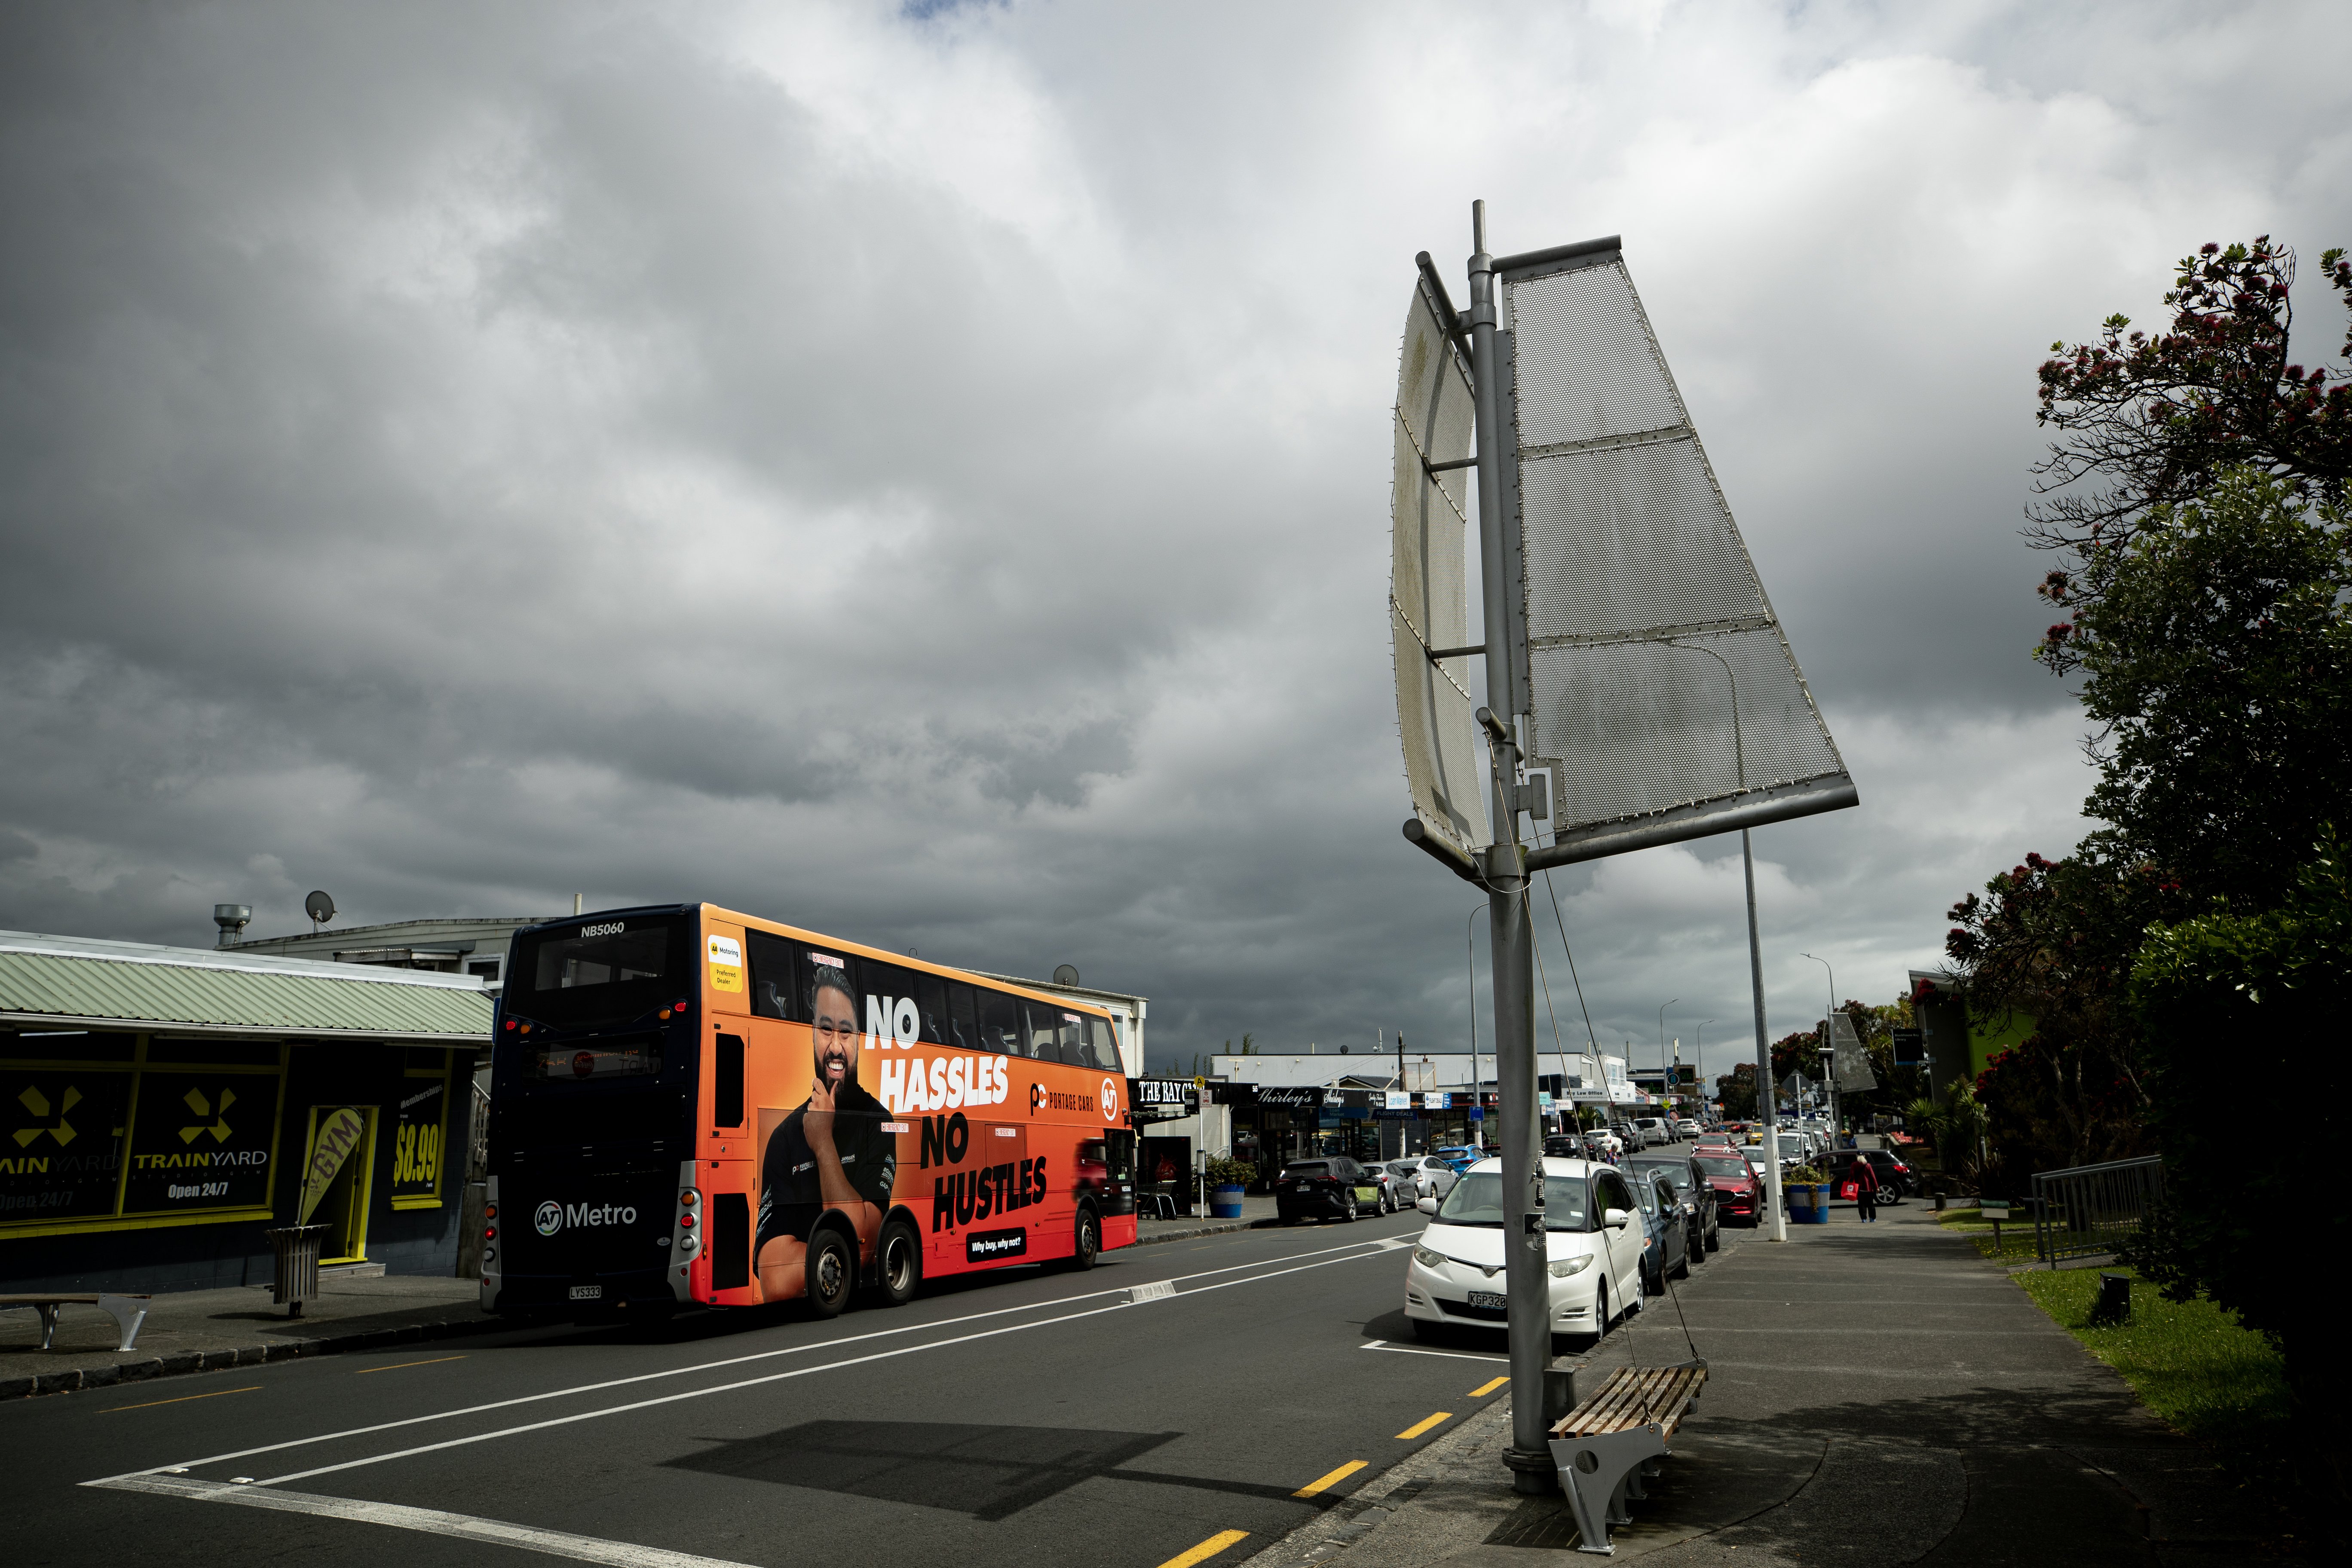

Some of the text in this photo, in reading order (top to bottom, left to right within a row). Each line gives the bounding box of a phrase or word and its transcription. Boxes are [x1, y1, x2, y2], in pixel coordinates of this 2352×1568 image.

[581, 922, 624, 937] NB5060
[720, 947, 738, 958] Motoring
[818, 955, 835, 965] EMERGENCY
[717, 969, 736, 977] Preferred
[865, 994, 920, 1049] NO
[879, 1055, 1008, 1114] HASSLES
[1139, 1081, 1160, 1102] THE
[1162, 1081, 1181, 1102] BAY
[401, 1084, 443, 1109] Memberships
[1049, 1092, 1076, 1111] PORTAGE
[1078, 1095, 1093, 1112] CARS
[1259, 1087, 1313, 1107] Shirley's
[1323, 1089, 1344, 1107] Shirley's
[1396, 1096, 1407, 1105] Market
[887, 1123, 900, 1131] EMERGENCY
[312, 1113, 360, 1179] GYM
[920, 1112, 969, 1170] NO
[133, 1151, 267, 1169] TRAINYARD
[393, 1121, 439, 1187] $8.99
[168, 1182, 229, 1199] Open 24/7
[880, 1181, 888, 1189] GAP
[39, 1190, 74, 1207] 24/7
[932, 1156, 1047, 1234] HUSTLES
[566, 1203, 637, 1228] Metro
[972, 1237, 1021, 1253] Why buy, why not?
[570, 1287, 600, 1298] LYS333
[1470, 1294, 1506, 1307] KGP320
